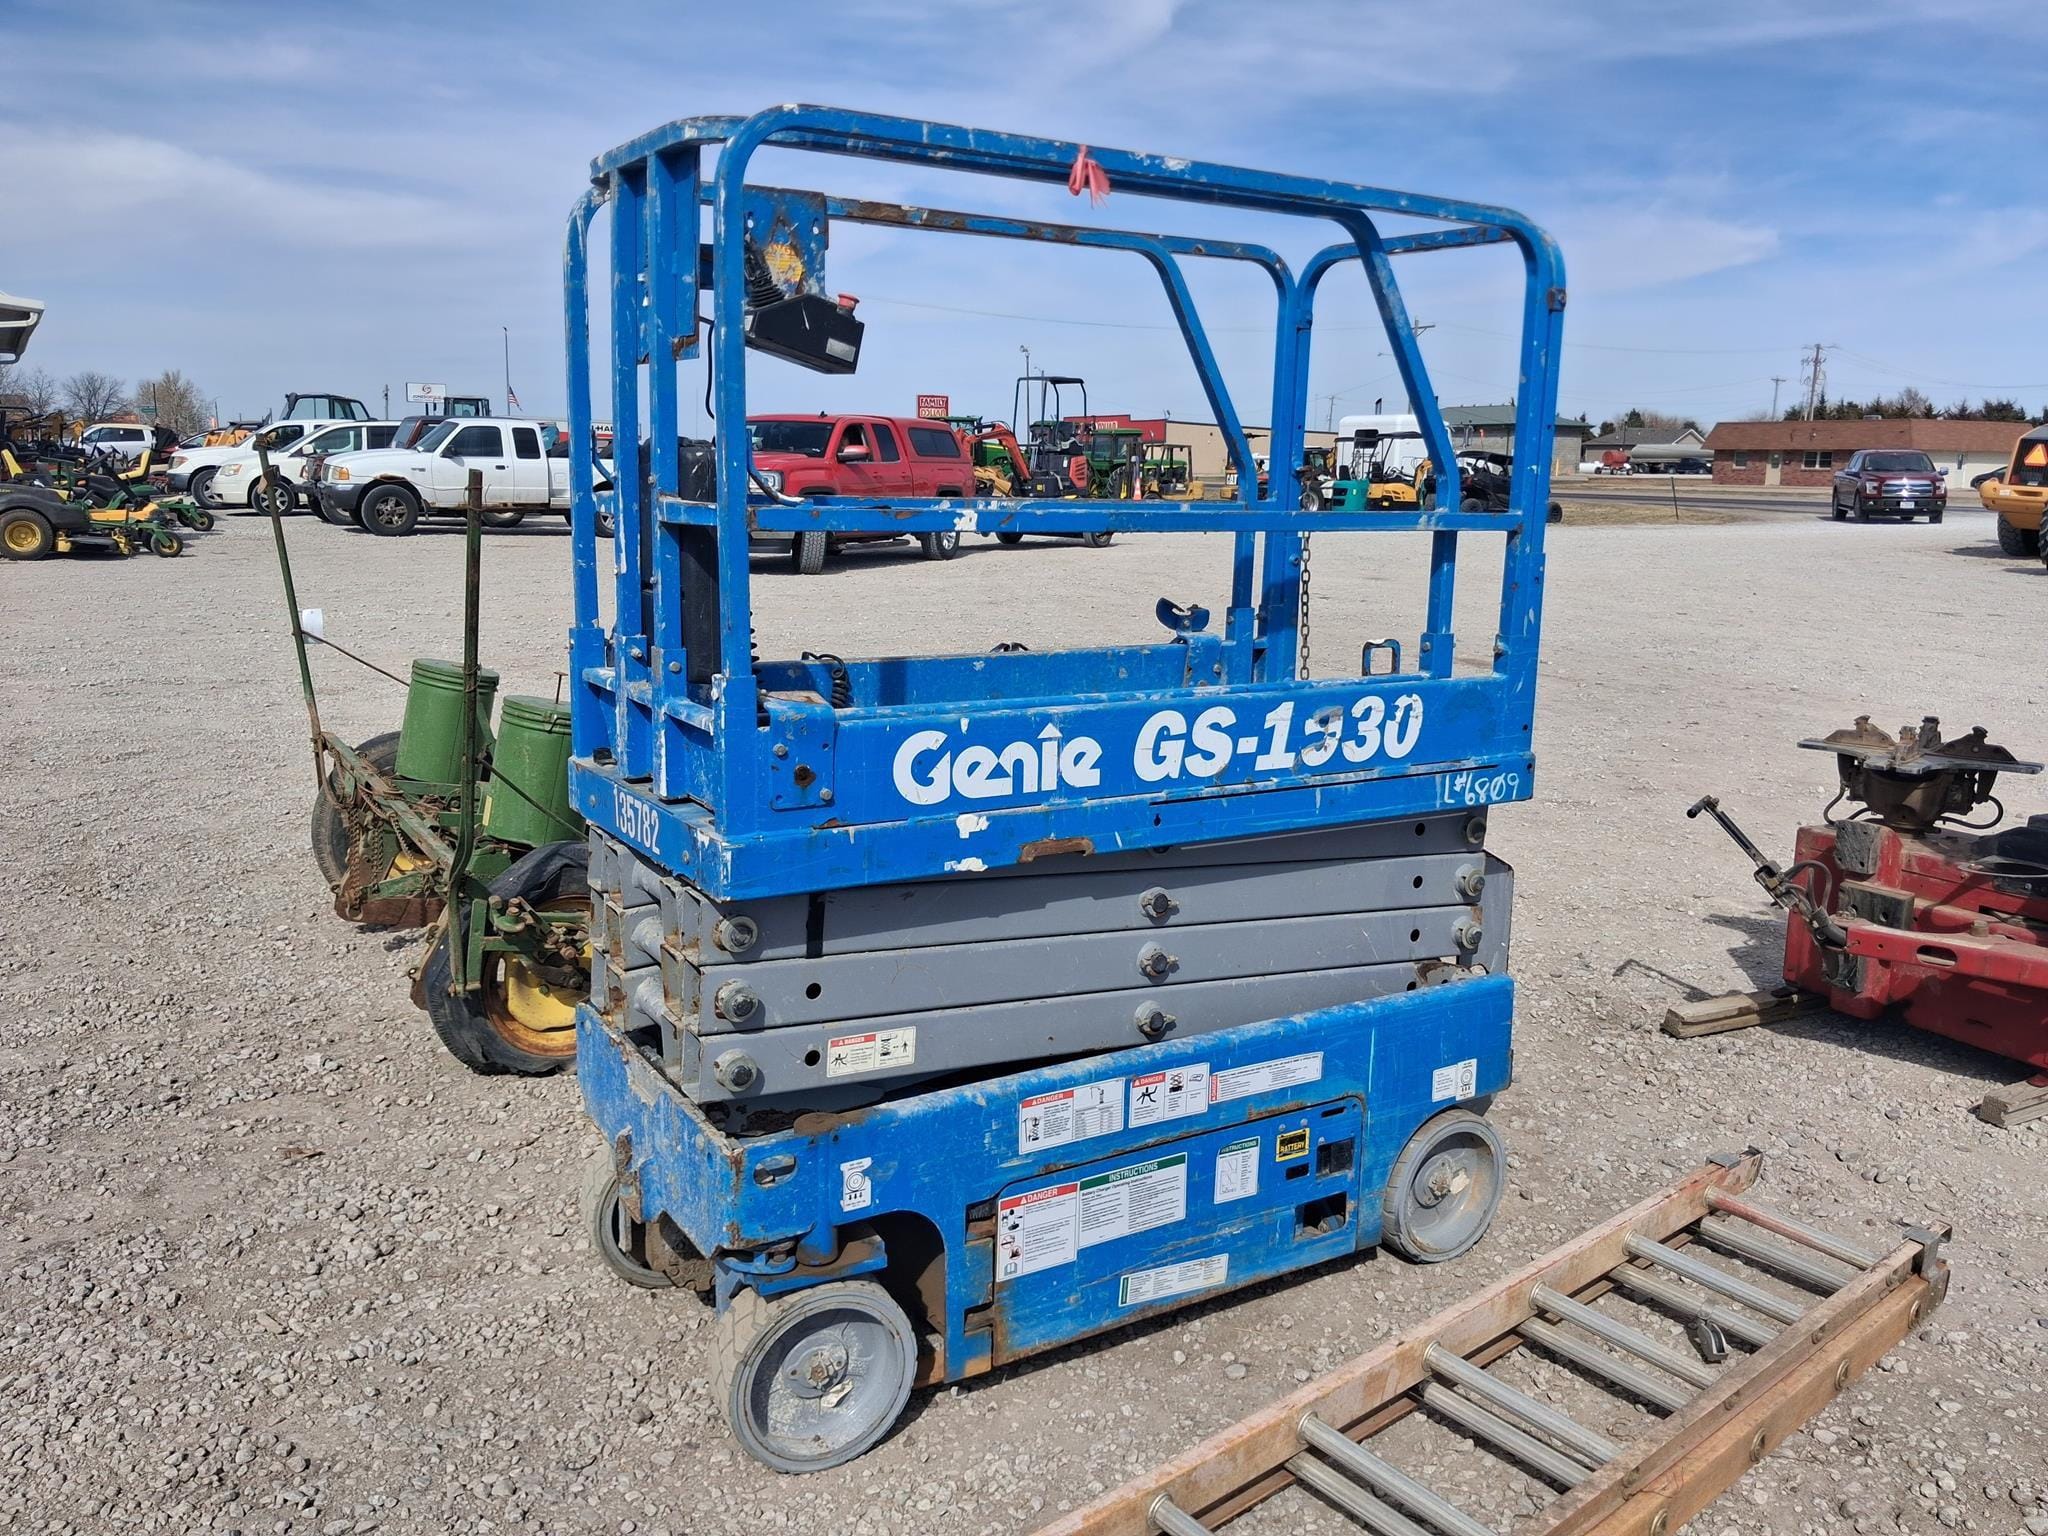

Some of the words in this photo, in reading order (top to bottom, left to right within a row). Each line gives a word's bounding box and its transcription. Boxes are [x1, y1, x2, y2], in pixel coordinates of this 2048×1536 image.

[920, 397, 947, 407] FAMILY
[893, 722, 1103, 805] Genie
[613, 784, 660, 855] 135782
[1140, 1075, 1163, 1085] DANGER
[1037, 1093, 1064, 1104] DANGER
[1280, 1141, 1305, 1152] BATTERY
[1108, 1162, 1159, 1182] INSTRUCTIONS
[1027, 1188, 1058, 1203] DANGER
